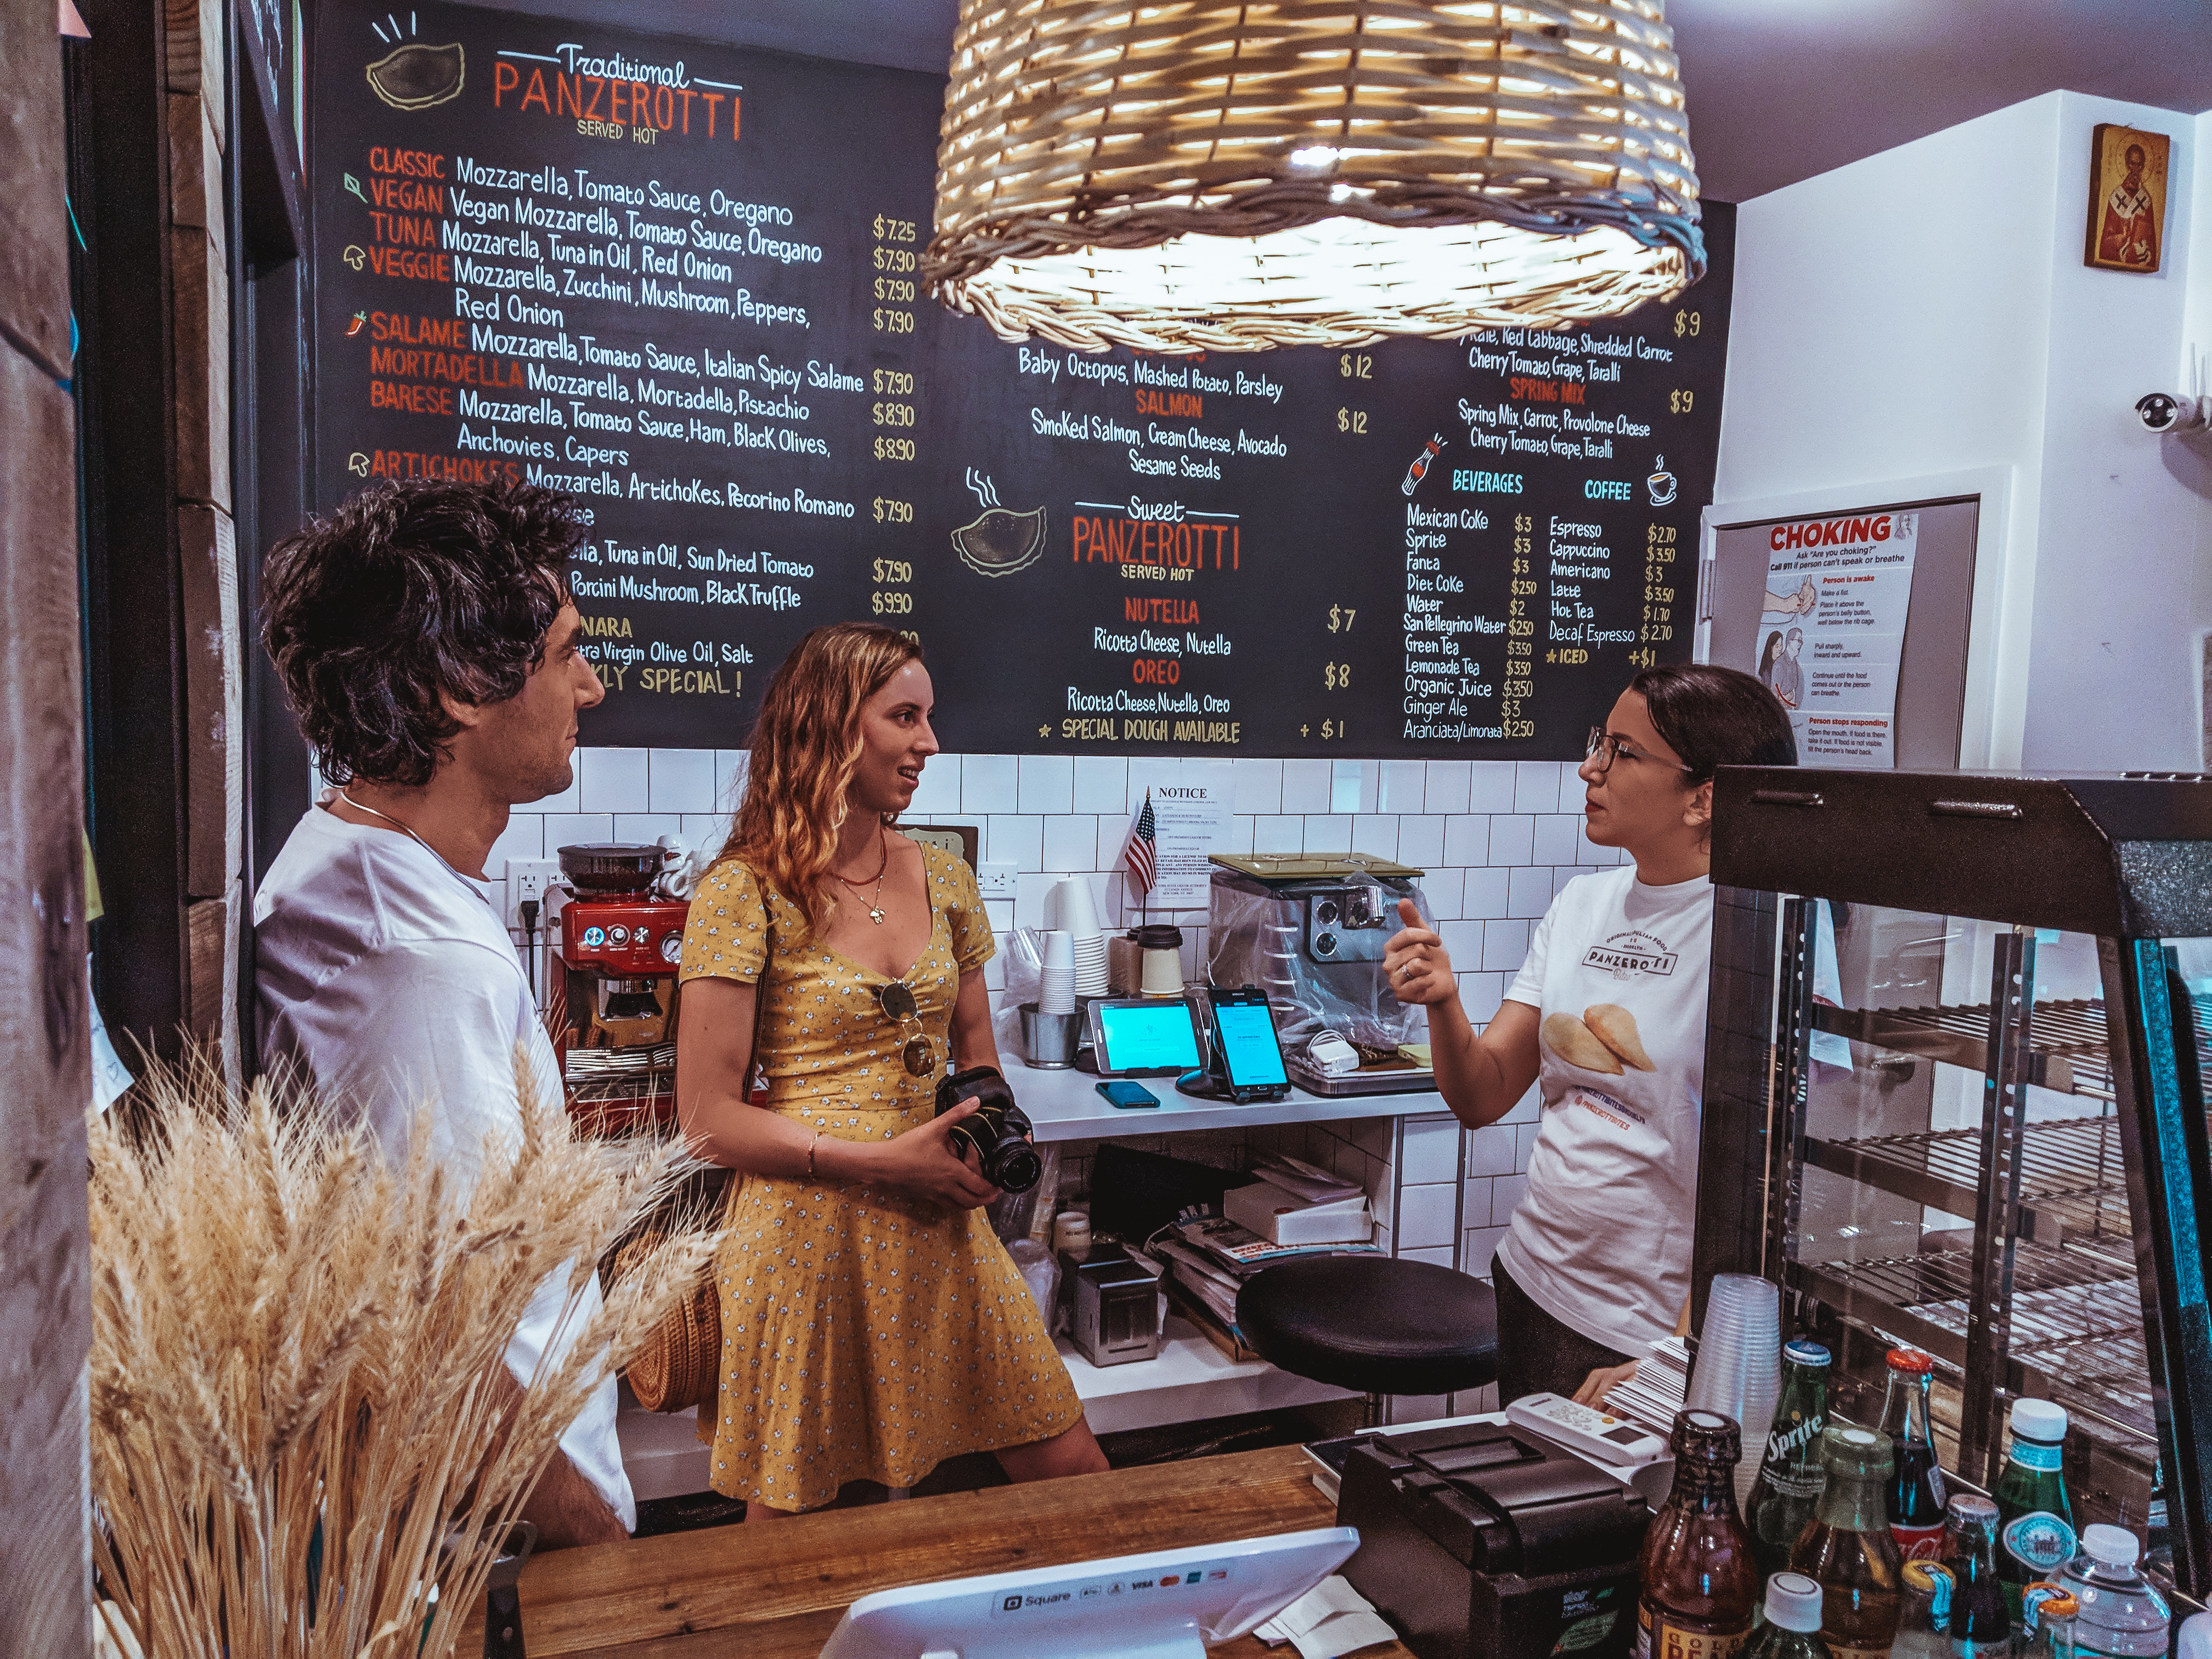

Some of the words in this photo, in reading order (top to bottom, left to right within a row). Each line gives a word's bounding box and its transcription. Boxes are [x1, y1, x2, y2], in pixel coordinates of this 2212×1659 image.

[556, 43, 690, 89] Traditional
[494, 61, 742, 142] PANZEROTTI
[577, 119, 624, 140] SERVED
[633, 126, 659, 145] HOT
[369, 146, 445, 179] CLASSIC
[457, 156, 573, 201] Mozzarella,
[574, 169, 645, 206] Tomato
[648, 179, 707, 218] Sauce,
[709, 188, 793, 228] Oregano
[873, 213, 916, 242] $7.25
[370, 177, 443, 215] VEGAN
[873, 245, 916, 273] $7.90
[369, 211, 436, 247] TUNA
[442, 219, 544, 264] Mozzarella,
[547, 233, 586, 265] Tuna
[589, 243, 604, 267] in
[606, 241, 638, 275] Oil,
[641, 244, 679, 277] Red
[683, 251, 733, 284] Onion
[874, 275, 915, 302] $7.90
[368, 245, 450, 283] VEGGIE
[873, 307, 914, 334] $7.90
[1580, 332, 1633, 358] Shredded
[1637, 336, 1673, 363] Carrot
[1674, 309, 1700, 338] $9
[370, 311, 466, 349] SALAME
[873, 368, 913, 395] $7.90
[1469, 346, 1509, 377] Cherry
[1508, 350, 1551, 379] Tomato,
[1551, 355, 1586, 385] Grape,
[1587, 359, 1621, 382] Taralli
[370, 345, 524, 388] MORTADELLA
[527, 362, 634, 404] Mozzarella,
[637, 377, 738, 416] Mortadella,
[738, 388, 810, 421] Pistachio
[872, 401, 915, 427] $8.90
[1018, 346, 1060, 384] Baby
[1067, 352, 1129, 387] Octopus,
[1134, 359, 1188, 389] Mashed
[1236, 370, 1283, 404] Parsley
[1340, 353, 1372, 379] $12
[1135, 388, 1203, 419] SALMON
[1510, 375, 1558, 402] SPRING
[1561, 382, 1586, 404] MIX
[1671, 389, 1693, 414] $9
[370, 380, 453, 415] BARESE
[459, 388, 568, 430] Mozzarella,
[568, 400, 633, 433] Tomato
[637, 409, 690, 443] Sauce,
[690, 417, 731, 448] Ham,
[778, 428, 831, 459] Olives,
[873, 436, 915, 461] $8.90
[1091, 415, 1144, 449] Salmon,
[1148, 422, 1187, 449] Cream
[1188, 426, 1235, 456] Cheese,
[1237, 428, 1287, 458] Avocado
[1338, 407, 1367, 434] $12
[1458, 398, 1497, 428] Spring
[1498, 403, 1523, 430] Mix,
[1523, 407, 1562, 433] Carrot,
[1563, 408, 1615, 435] Provolone
[1616, 414, 1651, 437] Cheese
[457, 422, 560, 462] Anchovies,
[565, 435, 629, 468] Capers
[1128, 448, 1177, 477] Sesame
[1180, 454, 1221, 481] Seeds
[1453, 469, 1523, 494] BEVERAGES
[1584, 479, 1632, 500] COFFEE
[873, 496, 913, 523] $7.90
[1127, 495, 1185, 523] Sweet
[1407, 503, 1458, 528] Mexican
[1515, 513, 1532, 533] $3
[1073, 516, 1239, 572] PANZEROTTI
[1405, 527, 1447, 552] Sprite
[1514, 535, 1531, 554] $3
[1550, 515, 1602, 539] Espresso
[1647, 523, 1676, 544] $2.70
[1770, 516, 1891, 551] CHOKING
[1549, 538, 1610, 560] Cappuccino
[1646, 545, 1675, 562] $3.50
[1770, 563, 1782, 571] Call
[1783, 562, 1793, 570] 911
[1793, 561, 1799, 569] if
[1799, 559, 1822, 571] person
[1823, 557, 1841, 568] can't
[1841, 555, 1864, 567] speak
[1875, 554, 1905, 563] breathe
[1796, 552, 1808, 560] Ask
[1825, 550, 1838, 558] you
[571, 570, 616, 597] Porcini
[619, 575, 704, 605] Mushroom,
[749, 583, 802, 611] Truffle
[872, 591, 912, 615] $9.90
[1822, 576, 1846, 584] Person
[1125, 596, 1200, 624] NUTELLA
[1328, 603, 1356, 633] $7
[1406, 593, 1444, 613] Water
[1509, 597, 1525, 616] $2
[1403, 612, 1424, 632] San
[1424, 613, 1474, 641] Pellegrino
[1474, 617, 1506, 634] Water
[1549, 619, 1584, 647] Decaf
[1587, 624, 1635, 650] Espresso
[1640, 623, 1672, 642] $2.70
[1405, 633, 1439, 653] Green
[1440, 636, 1459, 656] Tea
[1508, 639, 1532, 656] $3.50
[1559, 648, 1588, 664] ICED
[1132, 658, 1180, 685] OREO
[1325, 661, 1350, 691] $8
[1404, 674, 1454, 698] Organic
[1458, 678, 1492, 697] Juice
[1068, 686, 1114, 712] Ricotta
[1115, 689, 1158, 714] Cheese,
[1158, 691, 1202, 715] Nutella,
[1203, 694, 1230, 713] Oreo
[1403, 696, 1446, 723] Ginger
[1448, 698, 1468, 717] Ale
[1501, 700, 1520, 719] $3
[1062, 718, 1119, 741] SPECIAL
[1124, 719, 1168, 742] DOUGH
[1173, 720, 1240, 743] AVAILABLE
[1321, 718, 1344, 740] $1
[1503, 718, 1534, 739] $2.50
[1832, 718, 1849, 726] stops
[1850, 719, 1888, 728] responding
[1159, 787, 1207, 799] NOTICE
[1768, 1414, 1823, 1463] Sprite
[1025, 1593, 1071, 1607] Square
